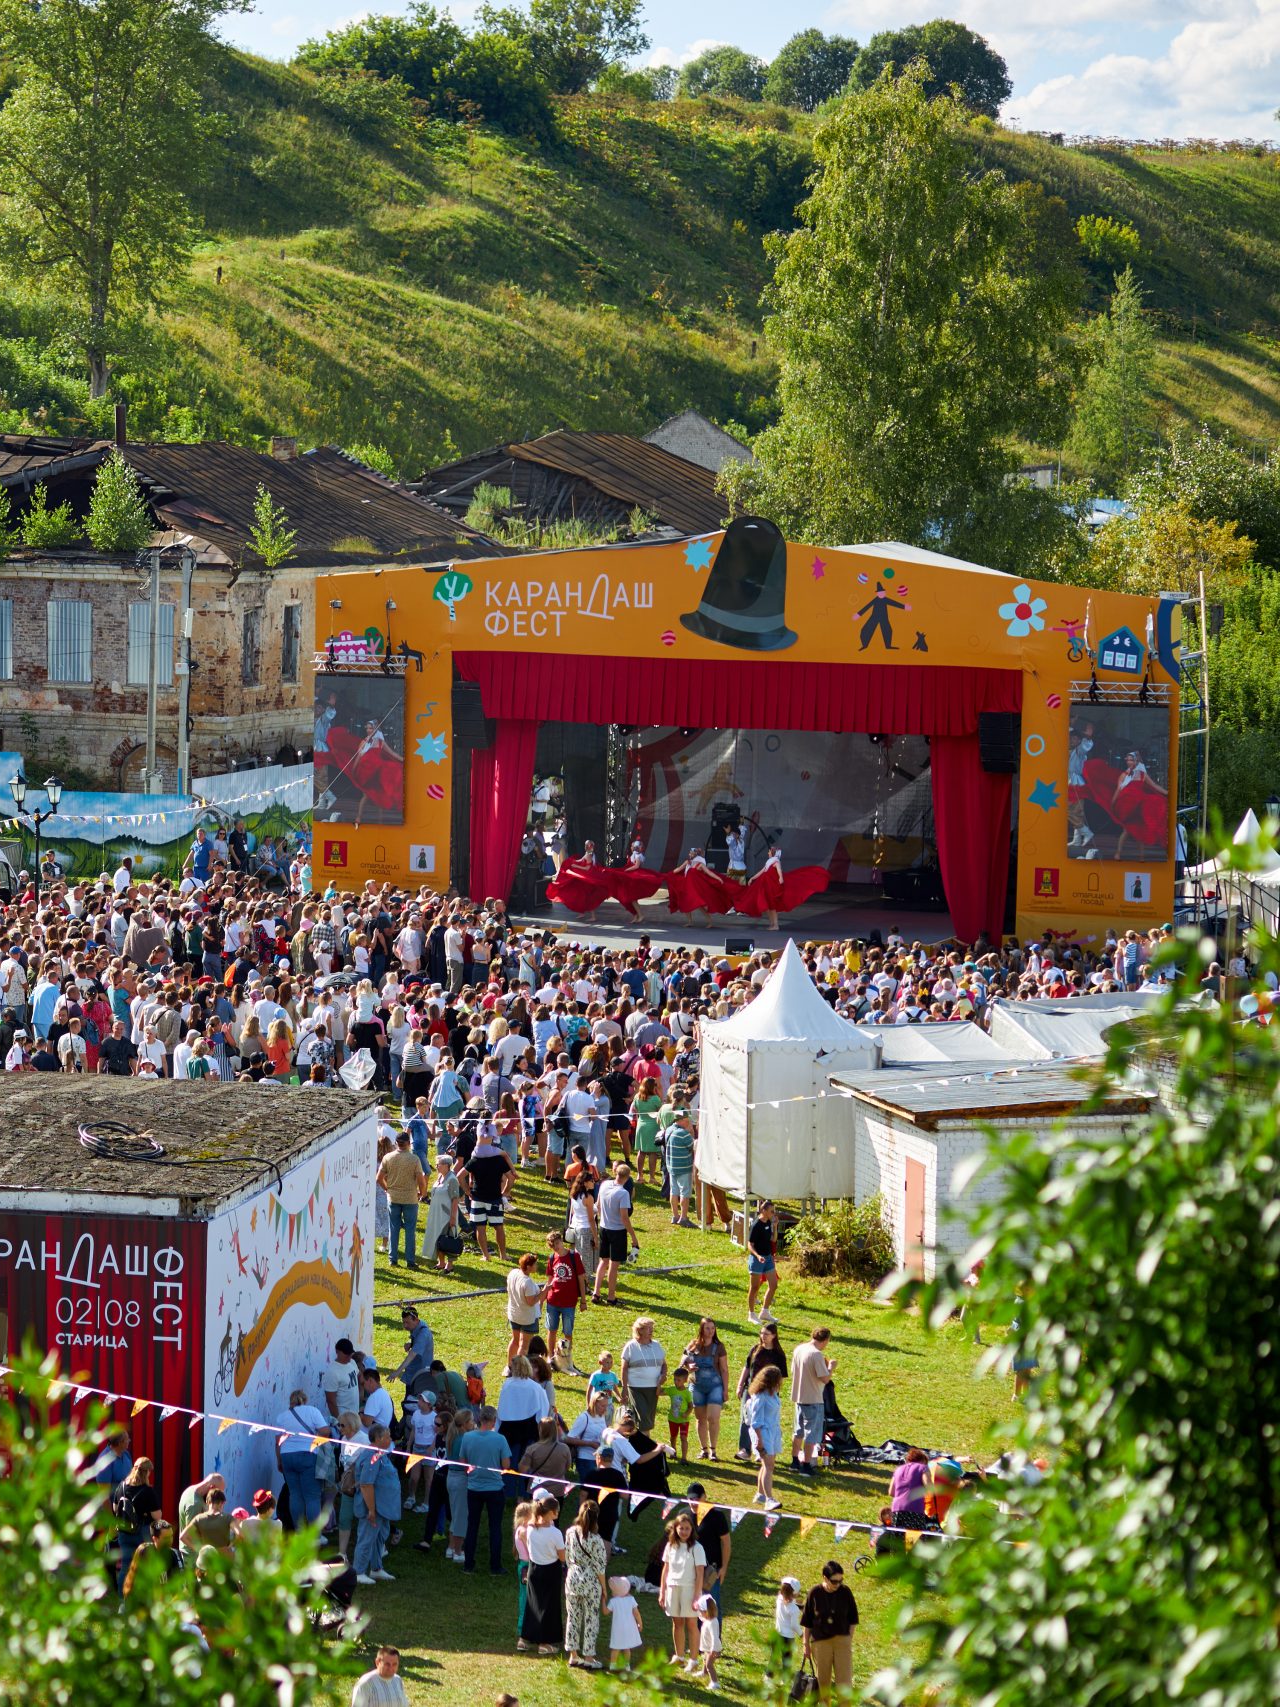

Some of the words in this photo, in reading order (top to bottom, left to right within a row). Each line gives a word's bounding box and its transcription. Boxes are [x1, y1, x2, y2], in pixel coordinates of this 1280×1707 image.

[485, 573, 653, 620] КАРАНДАШ
[484, 610, 567, 636] ФЕСТ
[333, 1141, 365, 1183] КАРАНДАШ
[152, 1246, 184, 1350] ФЕСТ
[55, 1332, 128, 1349] СТАРИЦА
